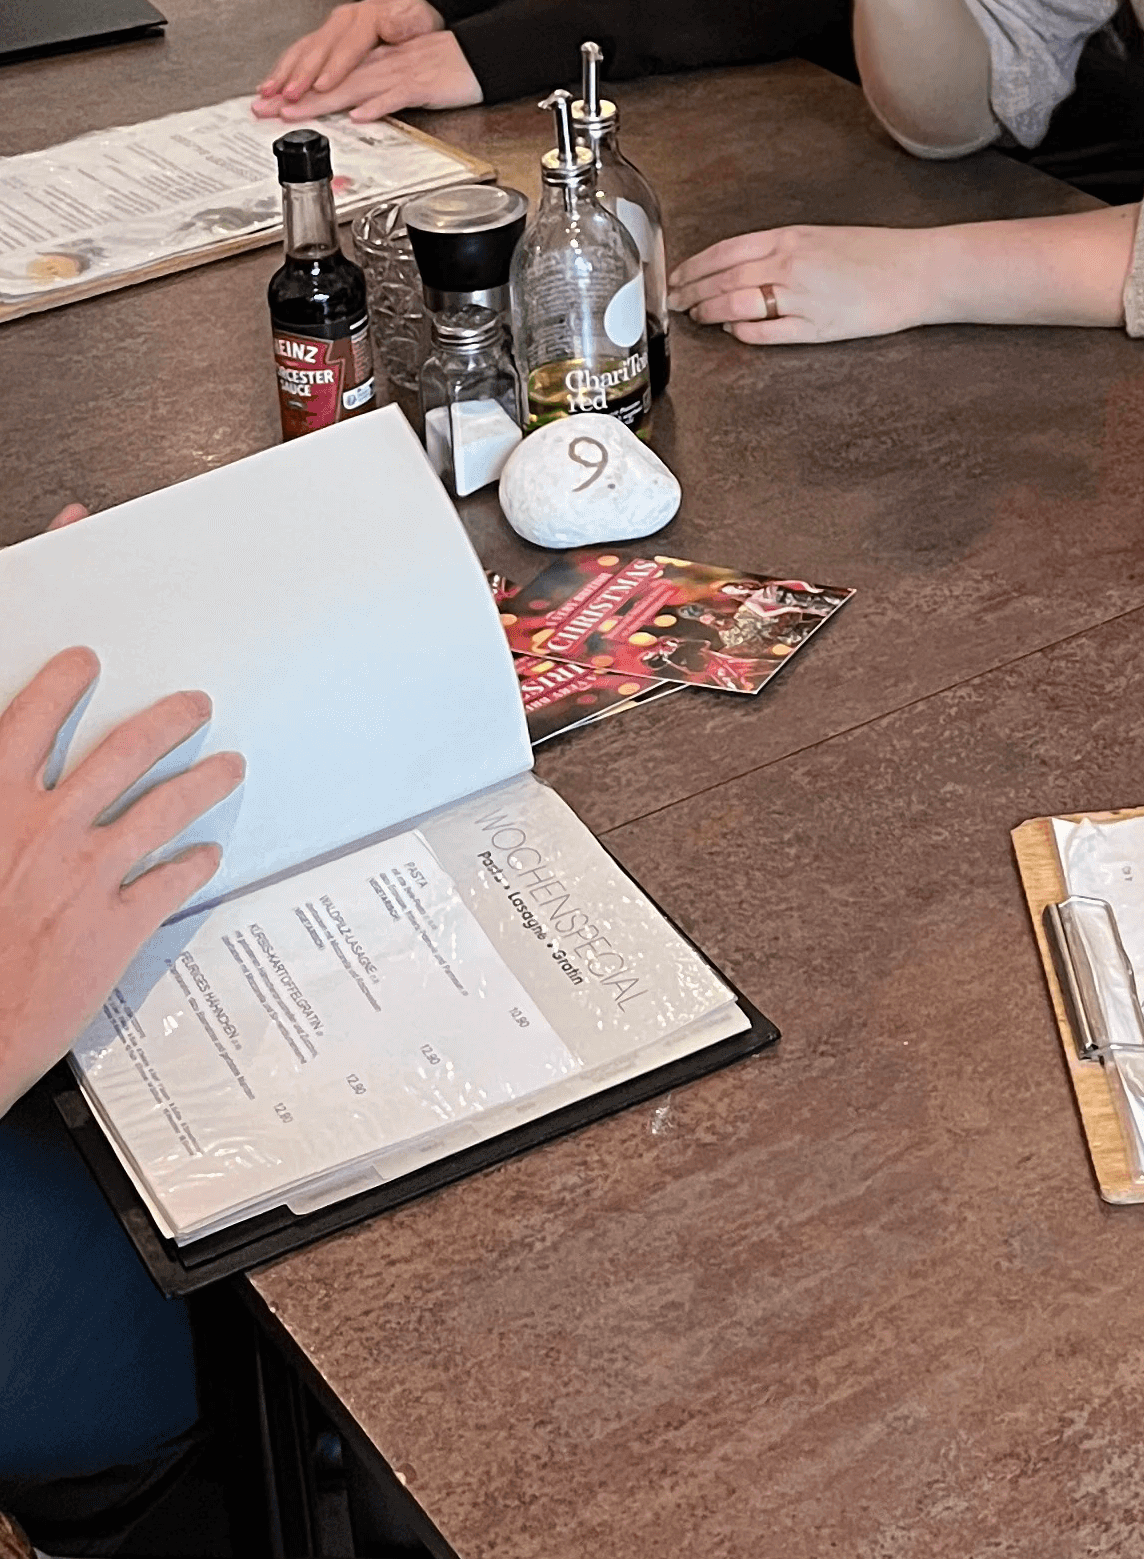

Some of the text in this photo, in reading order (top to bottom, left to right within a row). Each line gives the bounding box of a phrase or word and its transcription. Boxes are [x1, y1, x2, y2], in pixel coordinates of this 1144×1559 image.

[277, 339, 319, 364] EINZ
[566, 386, 608, 414] red
[567, 436, 609, 492] 9
[547, 562, 658, 651] CHRISTMAS
[471, 807, 657, 1013] WOCHENSPECIAL
[505, 890, 552, 942] Lasagne
[549, 948, 588, 986] Gratin
